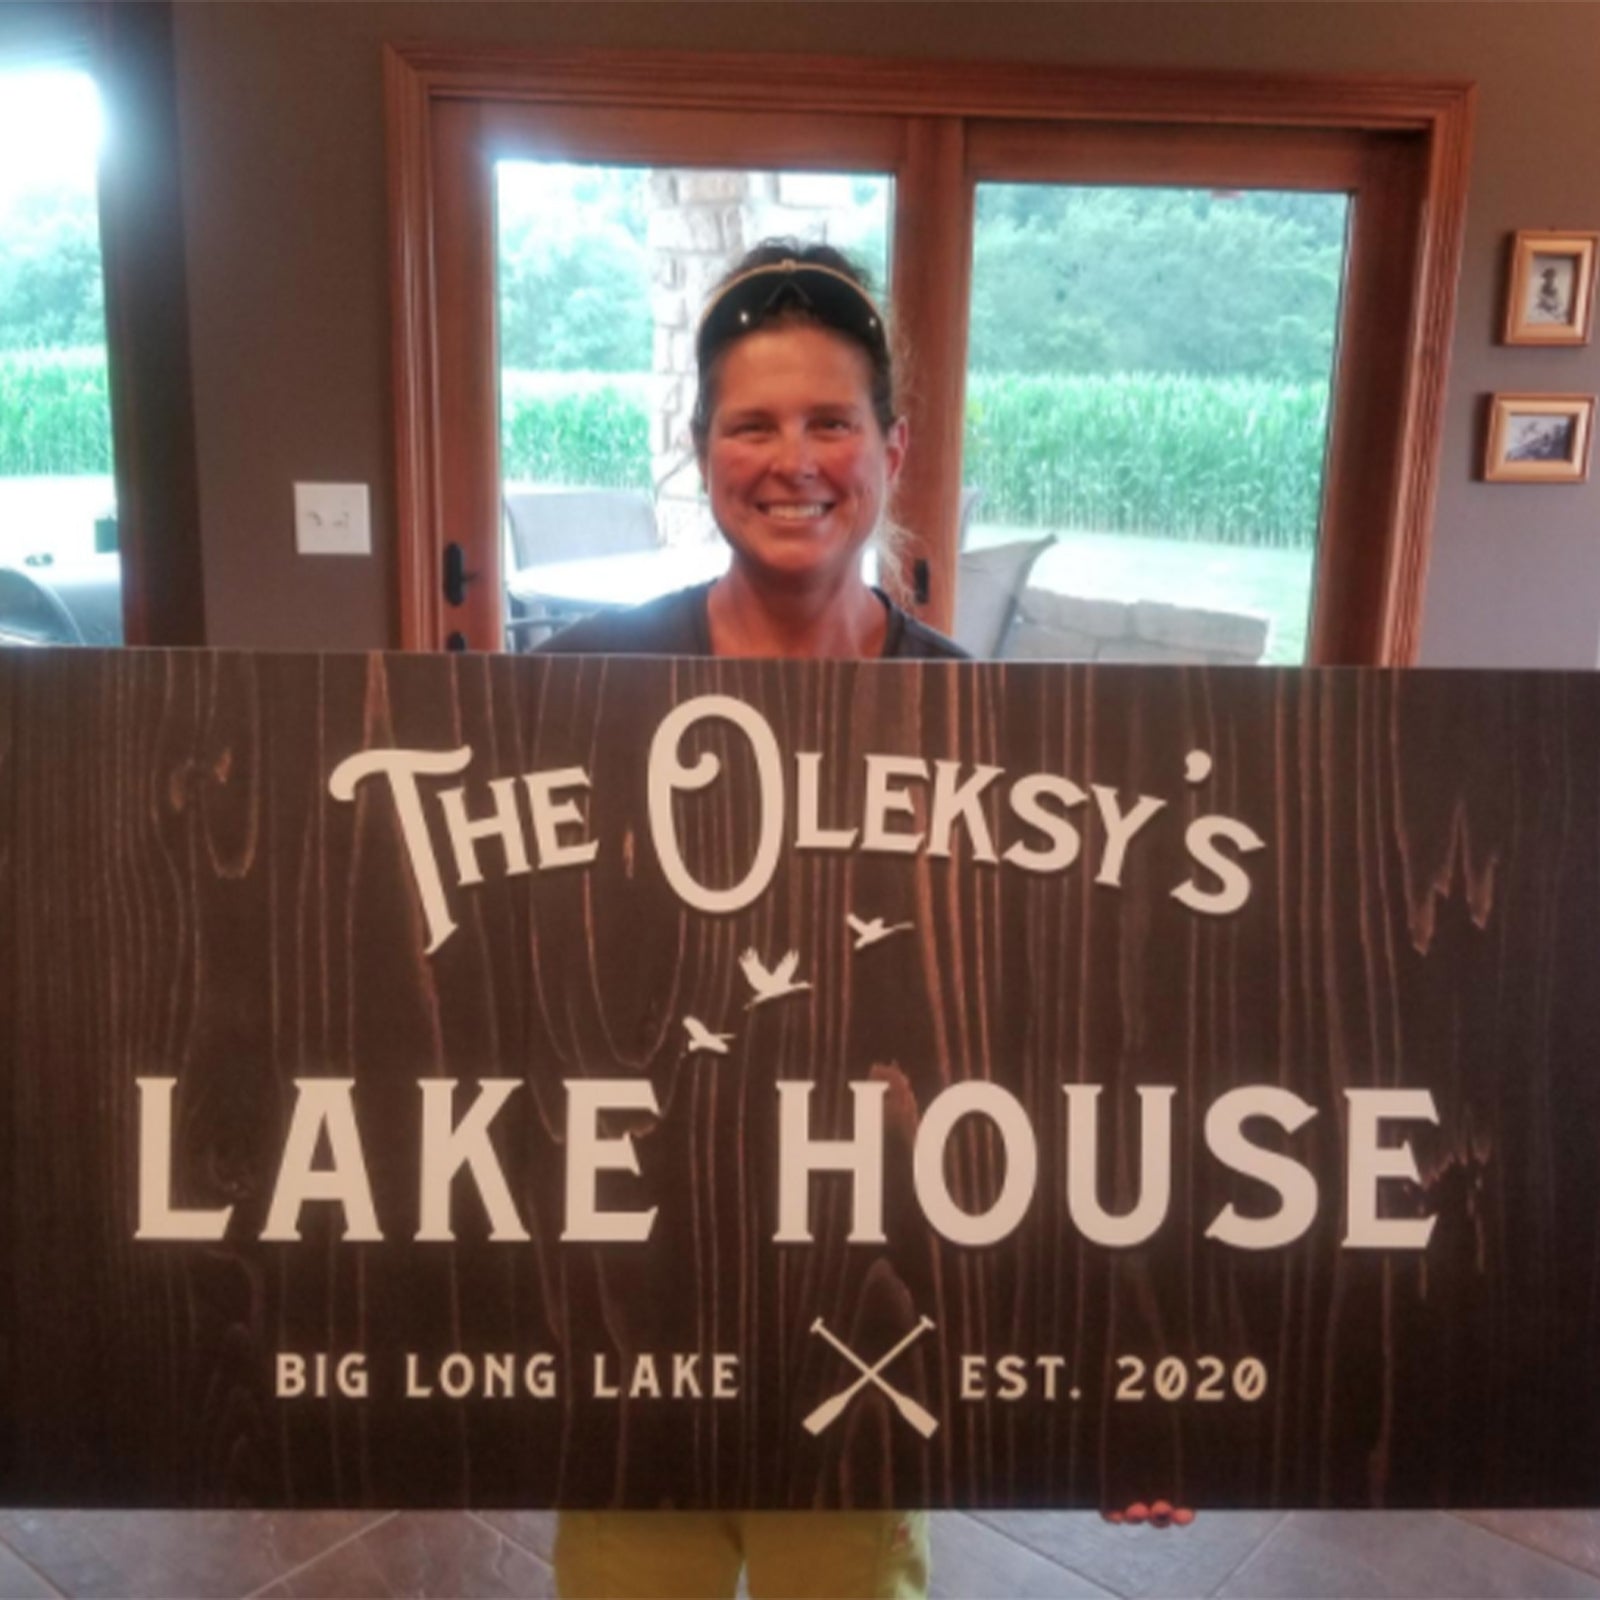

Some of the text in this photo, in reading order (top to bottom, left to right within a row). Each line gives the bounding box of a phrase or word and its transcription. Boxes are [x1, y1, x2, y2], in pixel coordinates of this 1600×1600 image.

[327, 693, 1266, 955] THE OLEKSY'S
[134, 1076, 1440, 1249] LAKE HOUSE
[276, 1352, 739, 1398] BIG LONG LAKE
[960, 1354, 1268, 1401] EST. 2020
